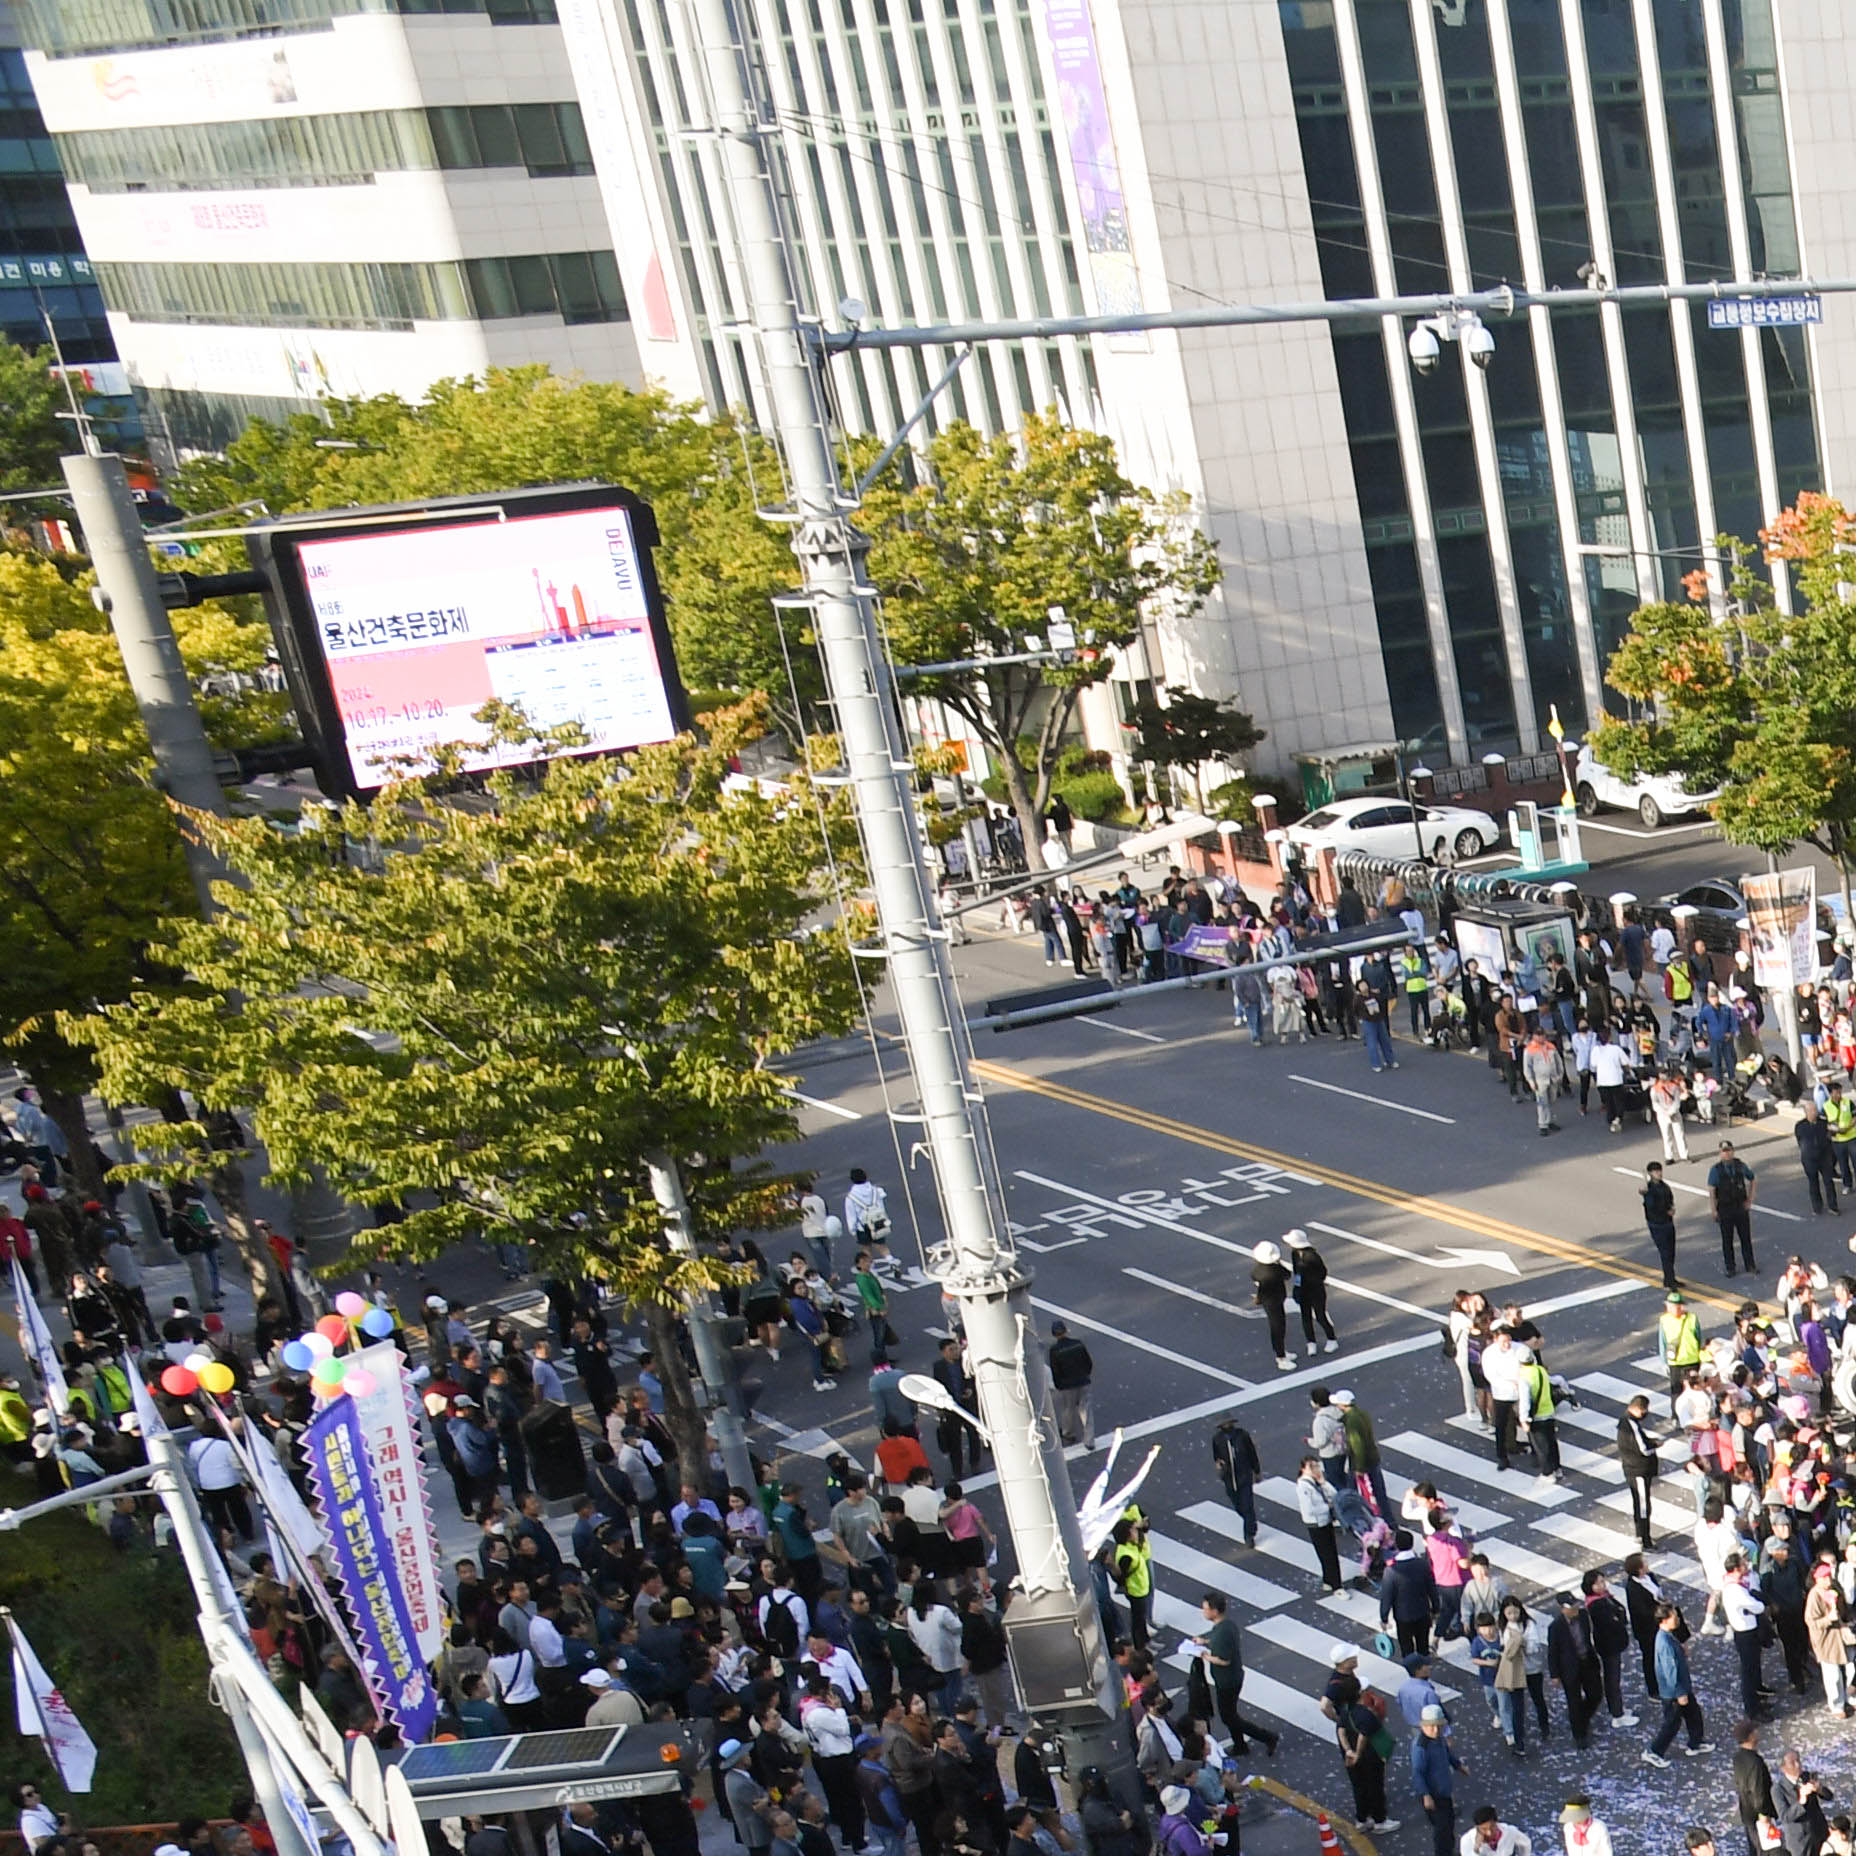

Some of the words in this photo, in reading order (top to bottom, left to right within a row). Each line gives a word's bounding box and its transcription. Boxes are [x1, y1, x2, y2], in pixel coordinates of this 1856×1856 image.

[30, 261, 63, 279] 미용
[1712, 300, 1820, 325] 교통정보수집장치
[604, 528, 633, 592] DEJAVU
[325, 606, 470, 651] 울산건축문화제
[373, 1424, 400, 1463] 그래
